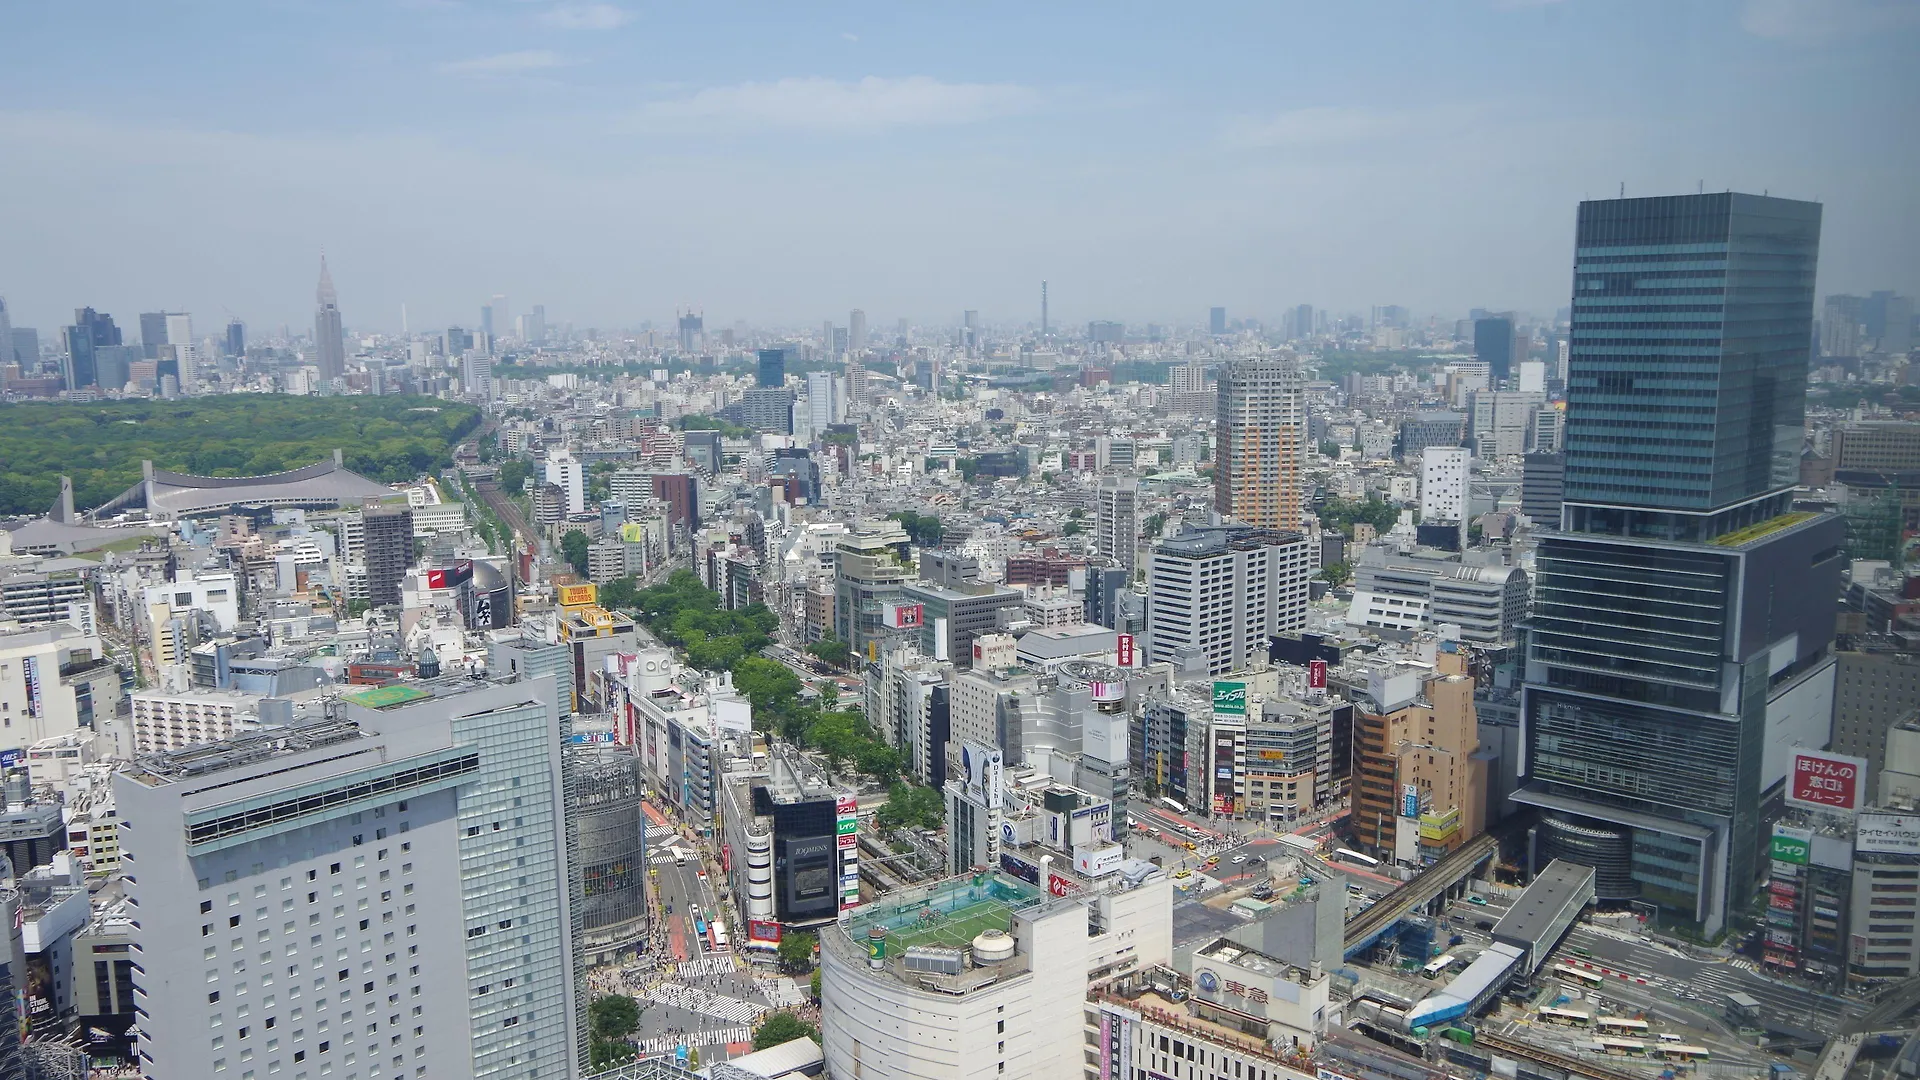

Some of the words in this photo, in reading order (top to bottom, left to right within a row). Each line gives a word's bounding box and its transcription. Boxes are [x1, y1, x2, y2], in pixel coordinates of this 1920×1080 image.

[568, 586, 588, 596] TOWER
[567, 594, 592, 603] RECORDS
[80, 604, 92, 636] PARCO
[1212, 689, 1246, 702] エイブル
[581, 733, 609, 743] SEIBU
[1797, 759, 1854, 779] ほけんの
[1809, 775, 1837, 792] 窓口
[1801, 789, 1846, 804] グループ
[838, 806, 856, 814] アコム
[839, 823, 855, 831] レイク
[1774, 842, 1806, 857] レイク
[1223, 979, 1269, 1005] 東急
